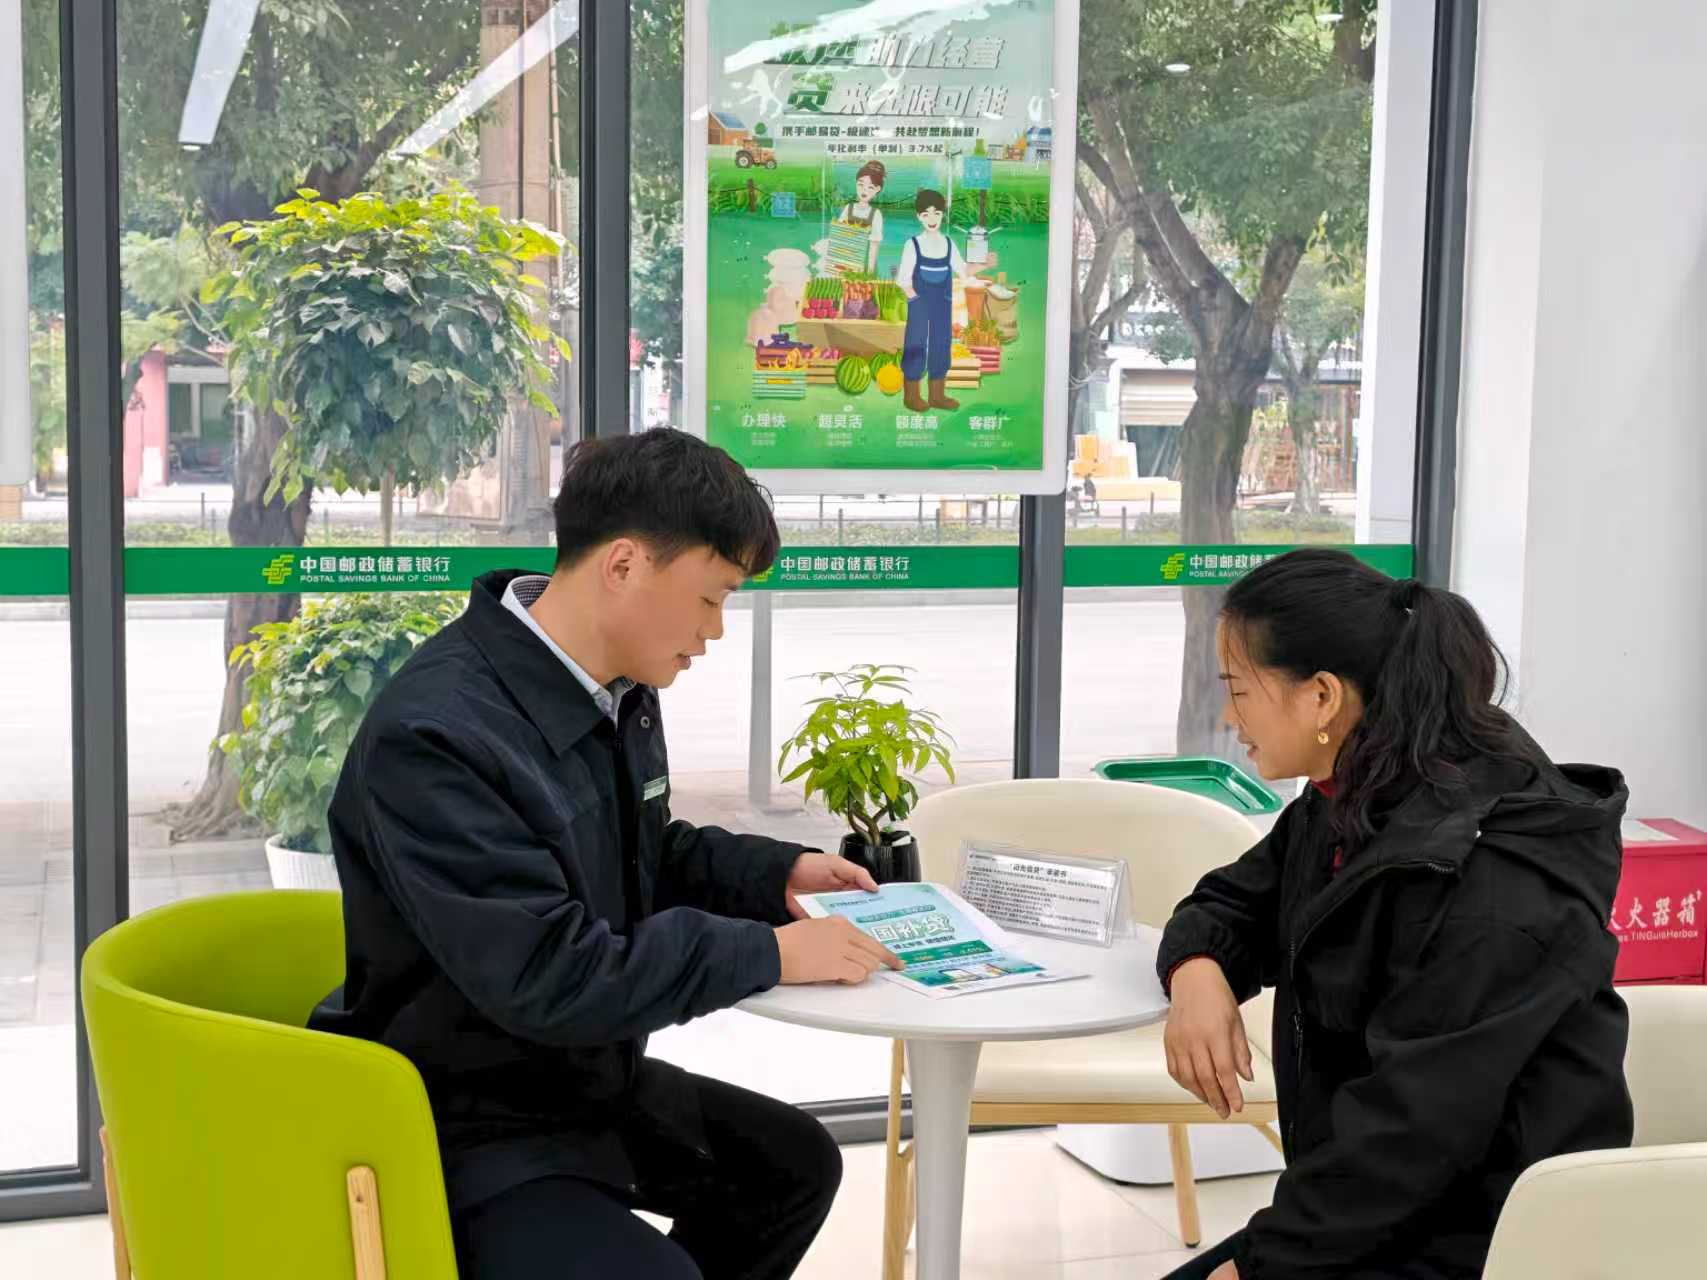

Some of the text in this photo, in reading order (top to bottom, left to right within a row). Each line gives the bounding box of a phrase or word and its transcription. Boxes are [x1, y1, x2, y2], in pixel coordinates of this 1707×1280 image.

[742, 413, 787, 430] 办理快
[300, 556, 451, 573] 中国邮政储蓄银行
[780, 556, 910, 572] 中国邮政储蓄银行
[300, 573, 451, 583] POSTAL SAVINGS BANK OF CHINA
[780, 572, 909, 581] POSTAL SAVINGS BANK OF CHINA
[1189, 570, 1217, 578] POSTAL
